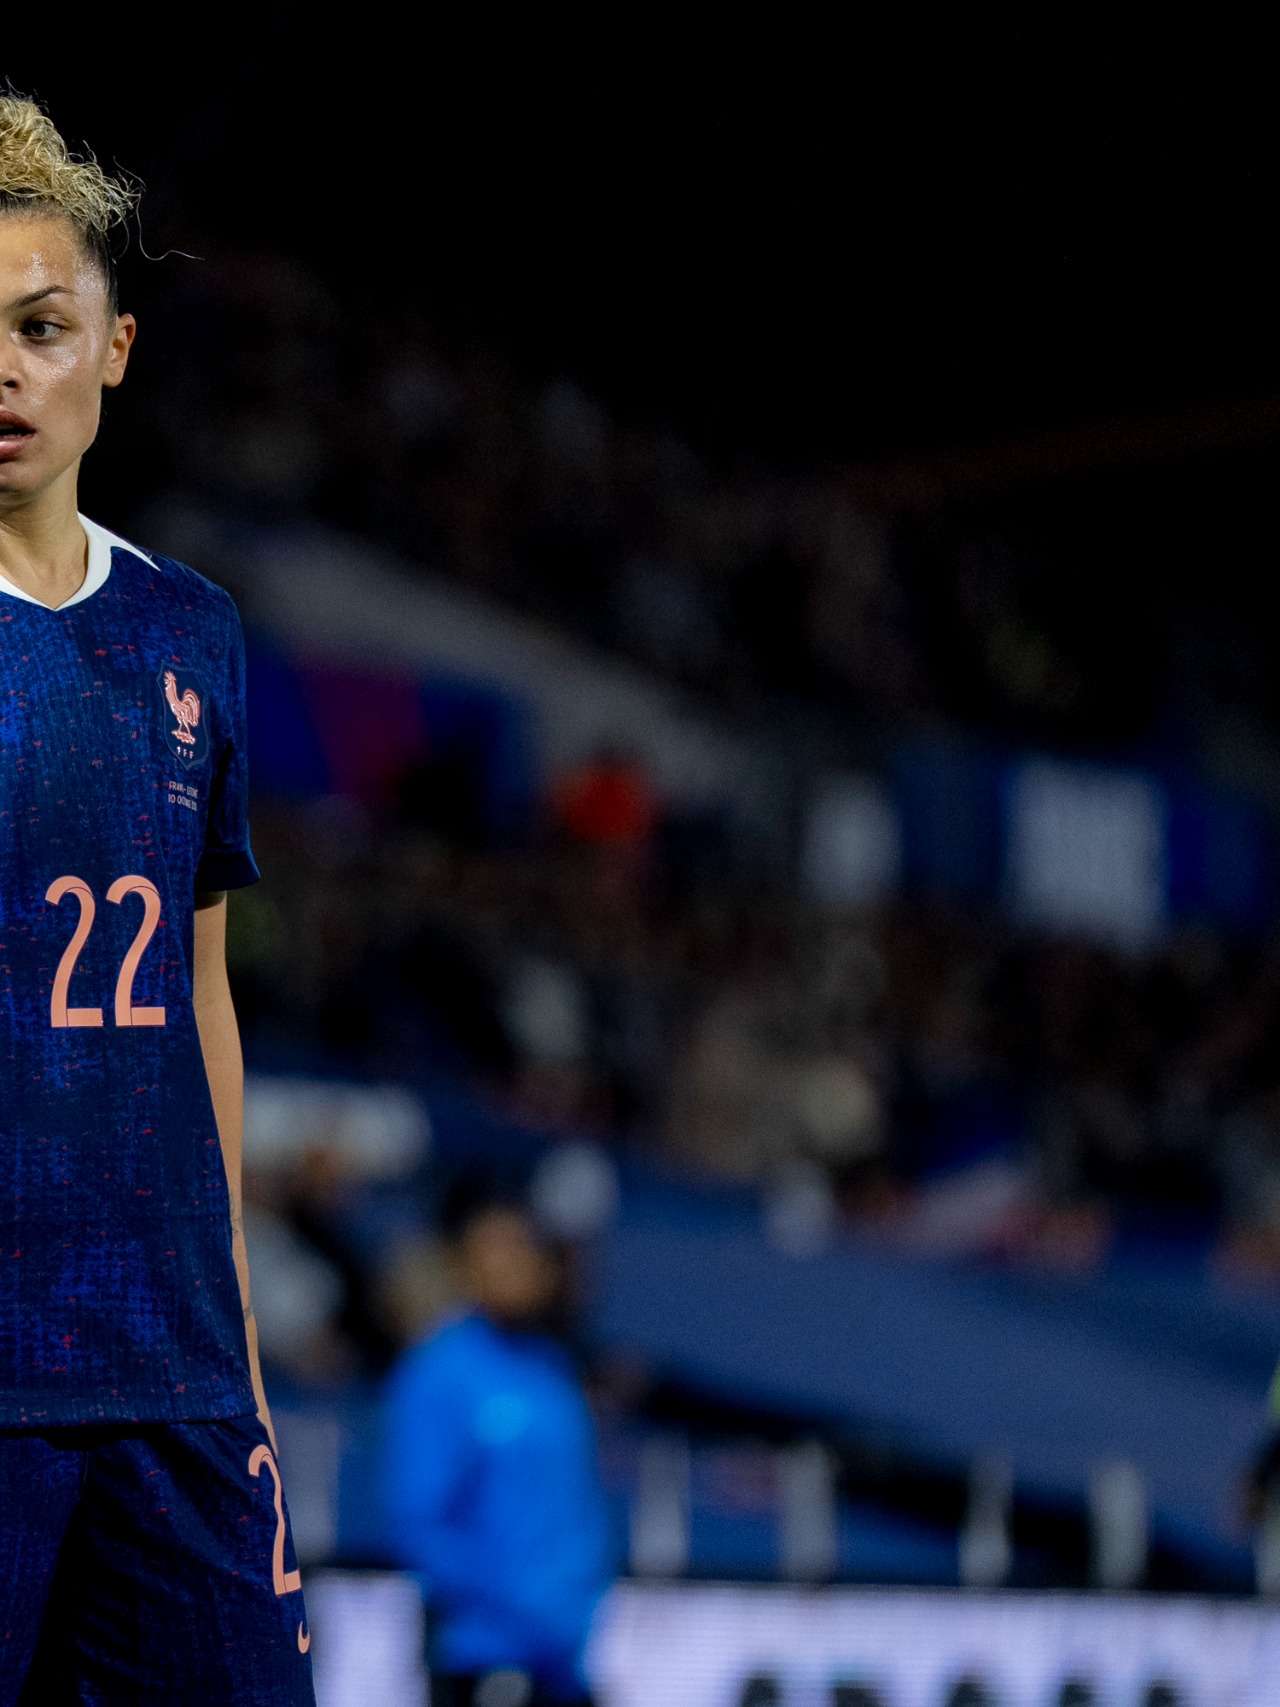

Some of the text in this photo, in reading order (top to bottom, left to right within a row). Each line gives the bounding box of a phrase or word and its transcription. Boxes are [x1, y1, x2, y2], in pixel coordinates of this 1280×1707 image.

[168, 794, 176, 803] 10
[45, 874, 166, 1028] 22
[248, 1444, 302, 1596] 2
